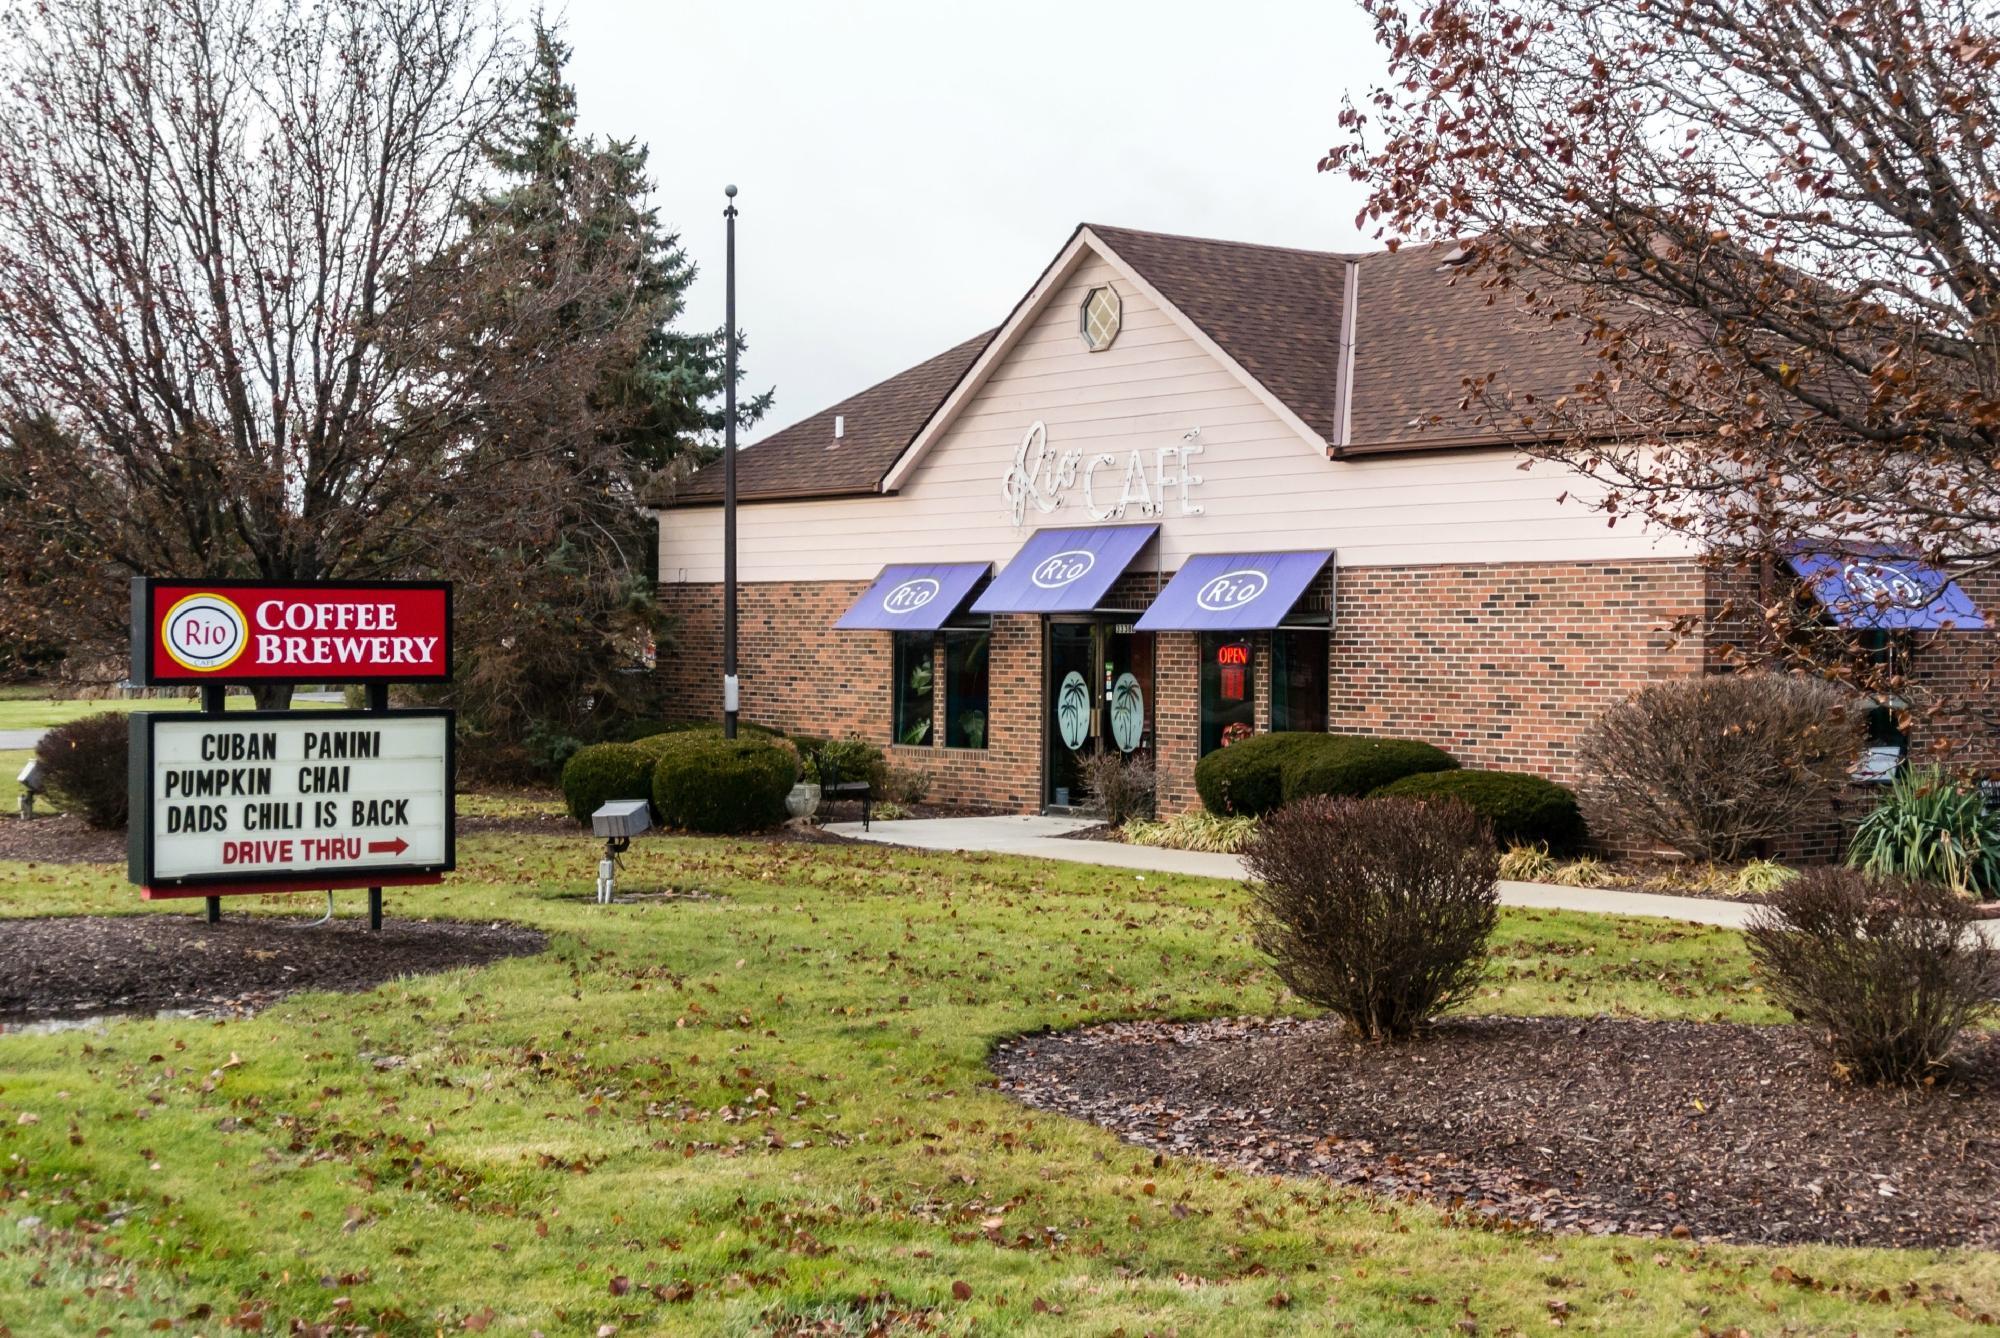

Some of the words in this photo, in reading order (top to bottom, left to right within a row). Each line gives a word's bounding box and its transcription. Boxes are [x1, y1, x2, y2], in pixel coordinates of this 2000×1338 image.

[1085, 425, 1205, 521] CAFÉ
[1040, 558, 1083, 580] Rio
[890, 586, 930, 606] Rio
[1206, 579, 1256, 602] Rio
[256, 600, 397, 631] COFFEE
[186, 620, 226, 646] Rio
[256, 634, 439, 664] BREWERY
[1219, 646, 1247, 665] OPEN
[201, 732, 277, 761] CUBAN
[303, 731, 380, 760] PANINI
[165, 767, 271, 798] PUMPKIN
[298, 765, 350, 794] CHAI
[167, 804, 227, 833] DADS
[244, 802, 302, 830] CHILI
[314, 801, 337, 828] IS
[352, 799, 409, 827] BACK
[222, 840, 293, 865] DRIVE
[300, 837, 361, 860] THRU
